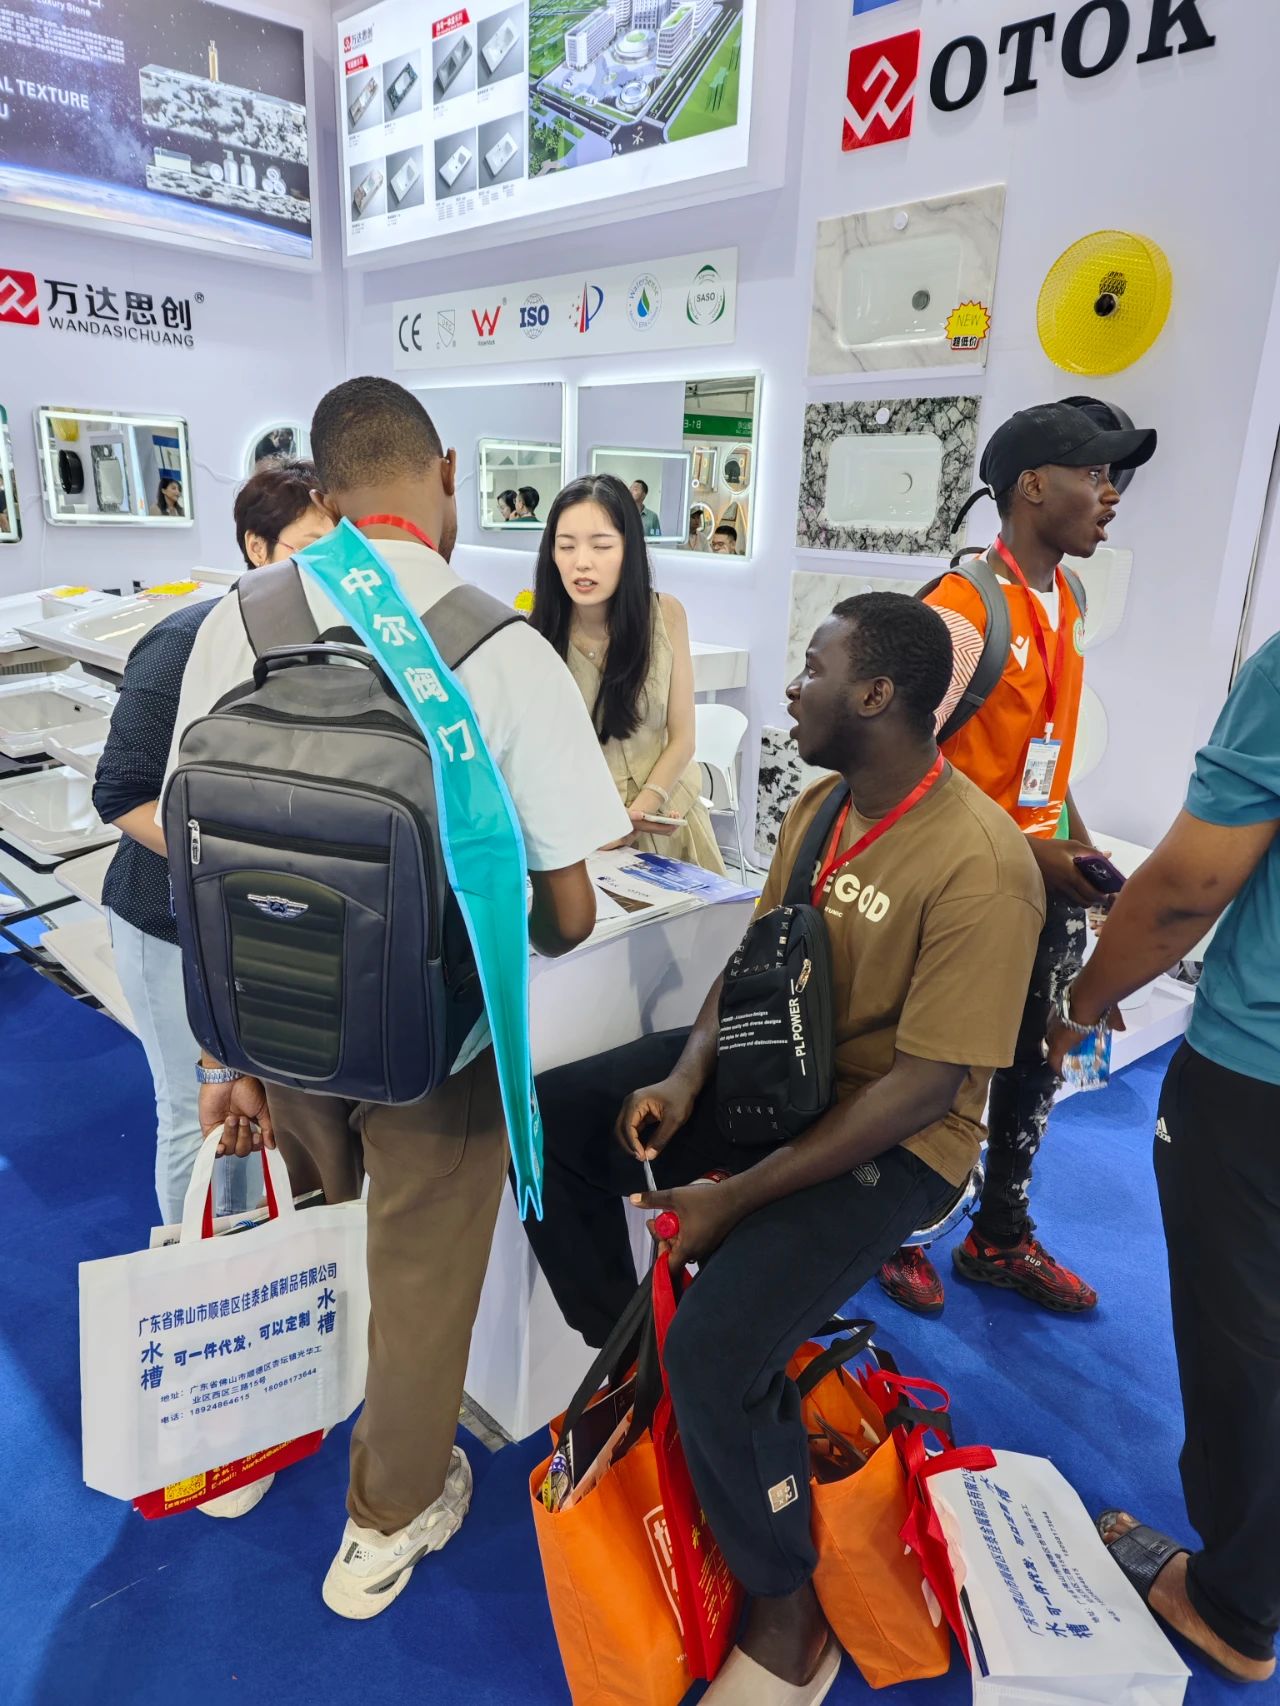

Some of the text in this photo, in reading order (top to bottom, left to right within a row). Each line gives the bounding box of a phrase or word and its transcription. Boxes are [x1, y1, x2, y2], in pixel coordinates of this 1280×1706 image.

[929, 0, 1216, 113] OTOK
[15, 78, 90, 112] TEXTURE
[44, 279, 193, 331] 万达思创
[696, 292, 716, 303] SASO
[49, 315, 195, 348] WANDASICHUANG
[398, 312, 423, 353] CE
[519, 304, 550, 329] ISO
[956, 313, 981, 327] NEW
[952, 336, 978, 347] 超低价
[788, 997, 807, 1057] PL POWER
[138, 1262, 338, 1338] 广东省佛山市顺德区佳泰金属制品有限公司
[317, 1287, 337, 1337] 水槽
[259, 1311, 311, 1341] 可以定制
[140, 1340, 165, 1392] 水槽
[189, 1393, 250, 1416] 18924864615
[264, 1367, 317, 1394] 18098173644
[191, 1375, 267, 1405] 业区西区三路15号
[1045, 1621, 1094, 1639] 水槽
